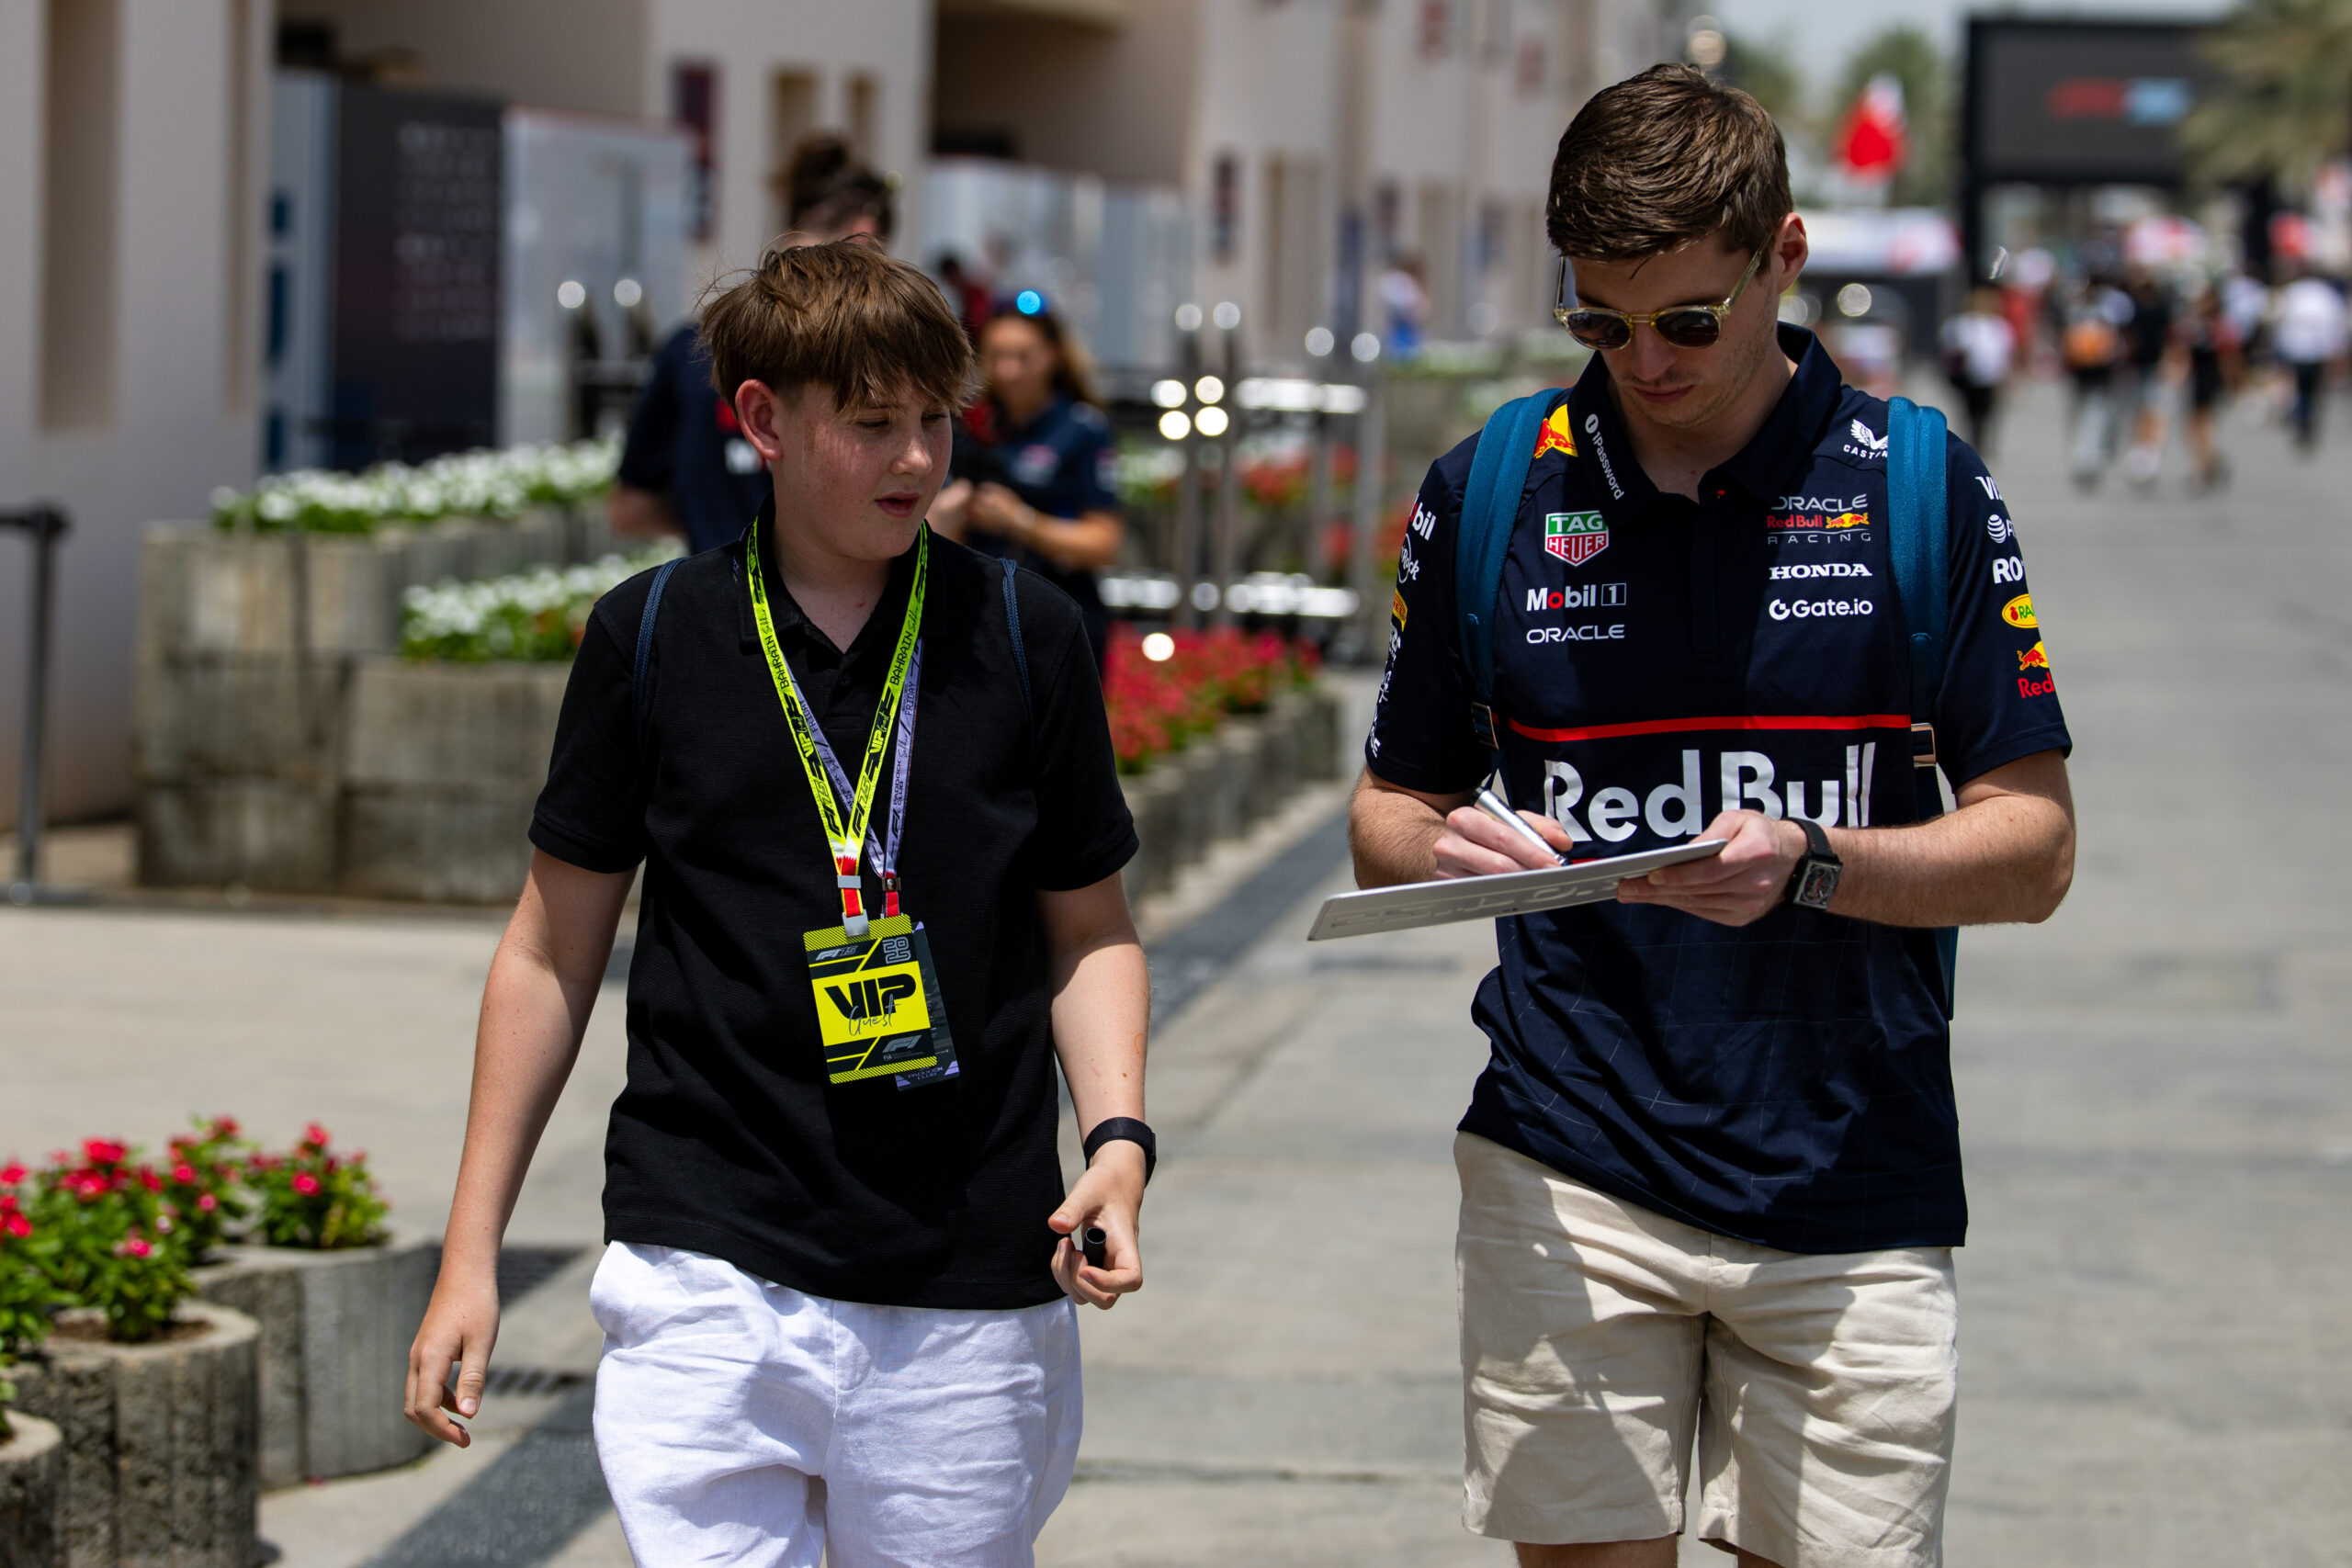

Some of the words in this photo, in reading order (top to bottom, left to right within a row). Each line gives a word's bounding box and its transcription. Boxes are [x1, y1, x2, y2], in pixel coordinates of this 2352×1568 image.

[1592, 430, 1625, 501] 1Password
[1974, 476, 2004, 501] VI
[1770, 493, 1869, 513] ORACLE
[1550, 513, 1603, 533] TAG
[1766, 513, 1794, 528] Red
[1796, 513, 1823, 528] Bull
[1548, 535, 1605, 563] HEUER
[1767, 532, 1871, 545] RACING
[1769, 563, 1873, 581] HONDA
[1992, 555, 2025, 584] RO
[1526, 584, 1597, 612] Mobil
[1792, 598, 1873, 619] Gate.io
[1526, 624, 1625, 644] ORACLE
[766, 635, 790, 690] BAHRAIN
[889, 630, 913, 686] BAHRAIN
[905, 681, 916, 716] FRIDAY
[2018, 671, 2055, 699] Red
[797, 731, 815, 758] VIP
[869, 729, 886, 754] VIP
[832, 773, 854, 809] ADDOCK
[893, 760, 902, 806] PADDOCK
[1544, 748, 1703, 843] Red
[1721, 741, 1876, 829] Bull
[823, 973, 917, 1021] VIP
[848, 993, 901, 1037] Guest
